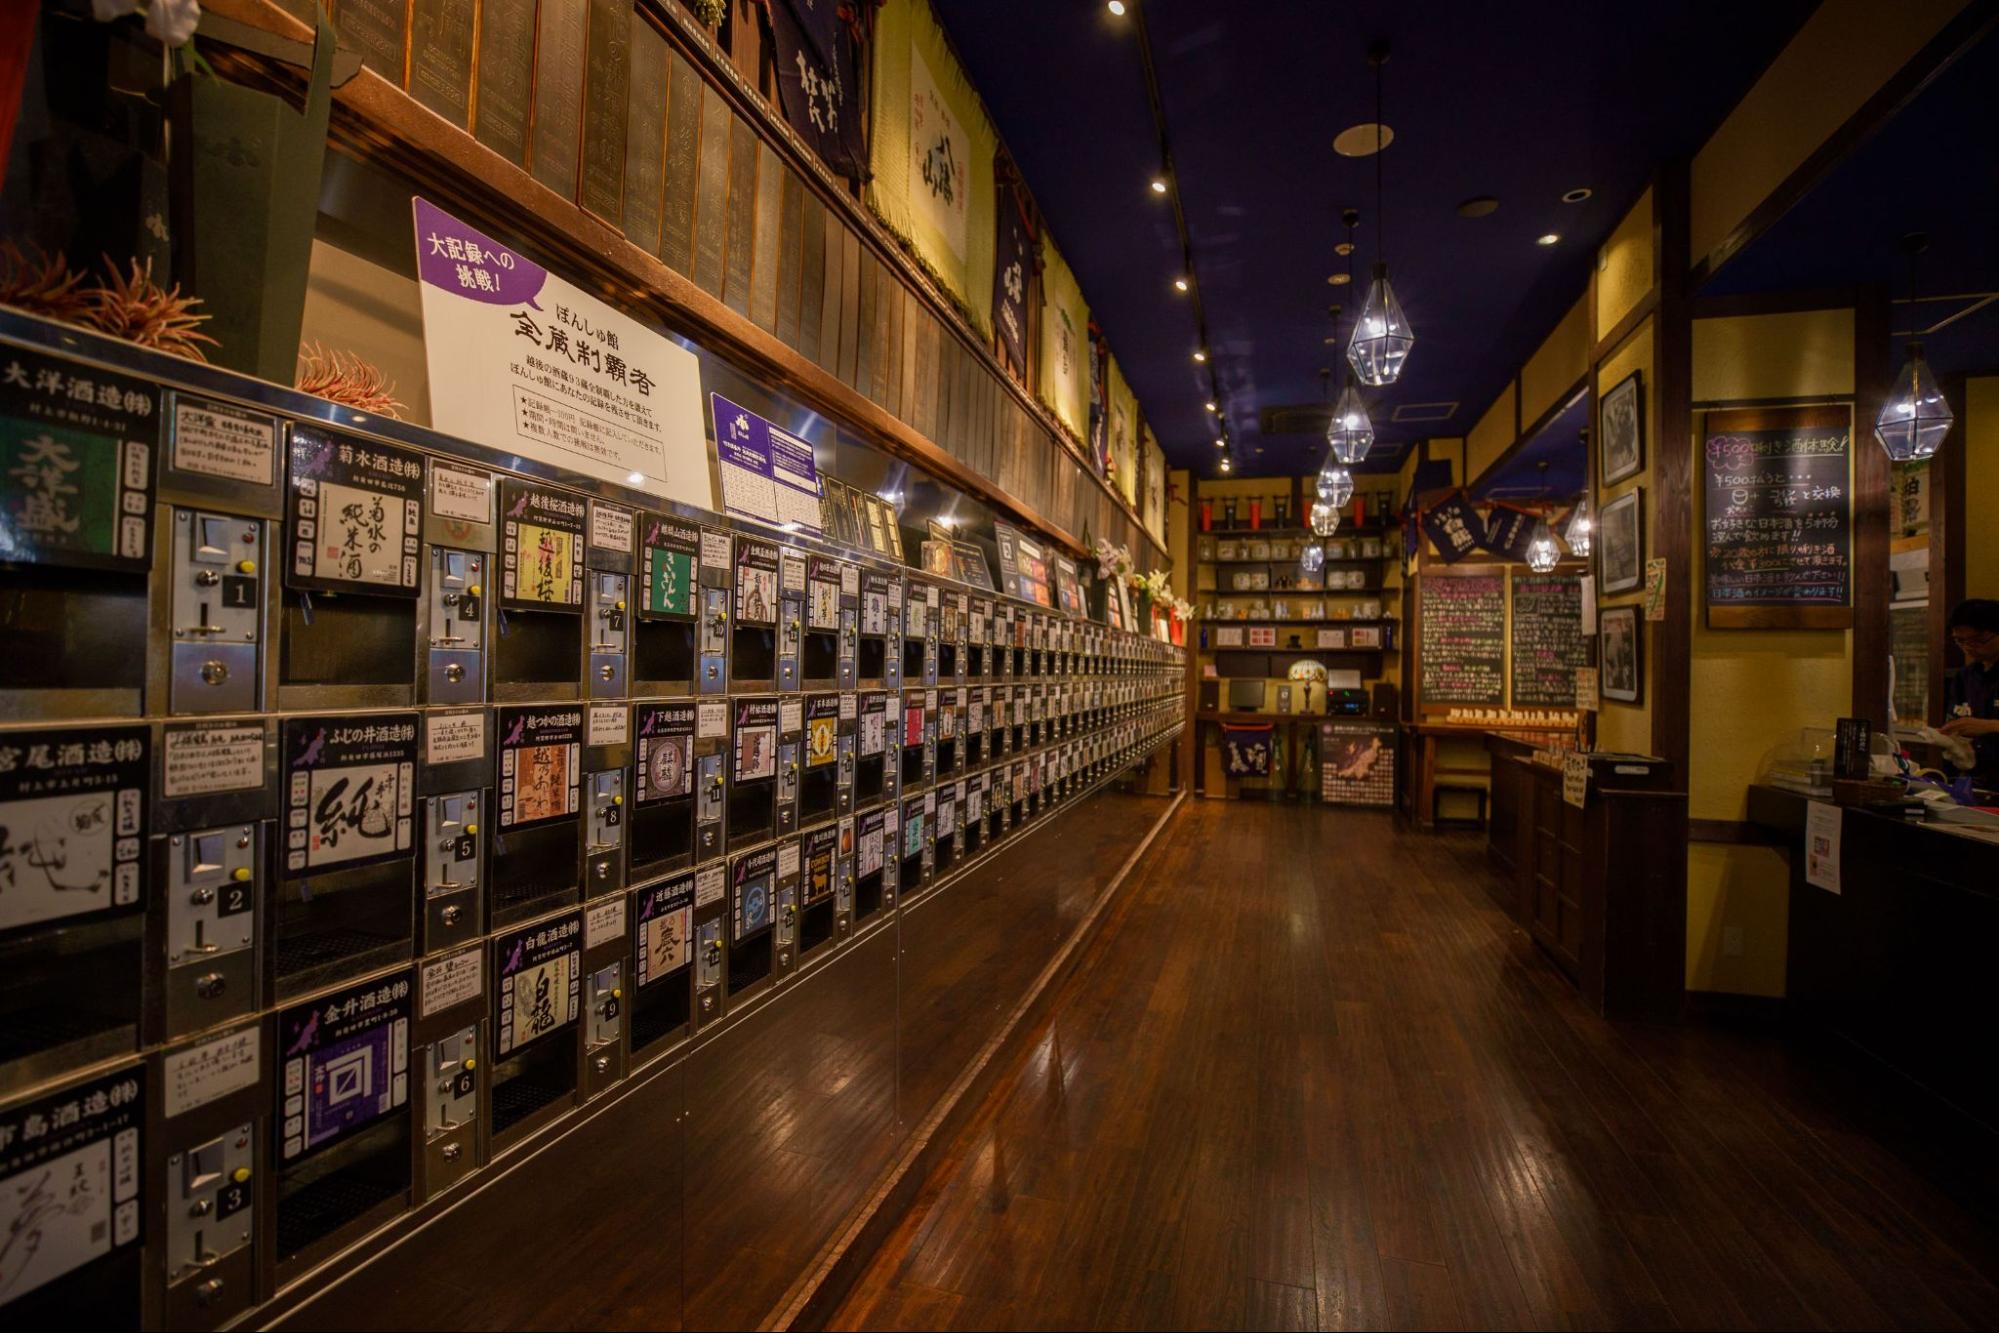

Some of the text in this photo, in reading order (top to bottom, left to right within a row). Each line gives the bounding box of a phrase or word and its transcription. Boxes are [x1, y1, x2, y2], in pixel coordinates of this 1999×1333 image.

[427, 232, 514, 270] 大記録への
[457, 267, 500, 292] 挑戦!
[556, 303, 619, 350] ぽんしゅ館
[368, 496, 387, 553] 菊水の
[235, 584, 245, 602] 1
[465, 602, 474, 617] 4
[614, 616, 621, 628] 7
[330, 724, 415, 744] ふじの井酒造㈱
[610, 810, 617, 823] 8
[462, 840, 471, 857] 5
[229, 891, 243, 910] 2
[324, 980, 409, 1025] 金升酒造㈱
[609, 1003, 616, 1015] 9
[461, 1076, 470, 1091] 6
[228, 1188, 243, 1210] 3
